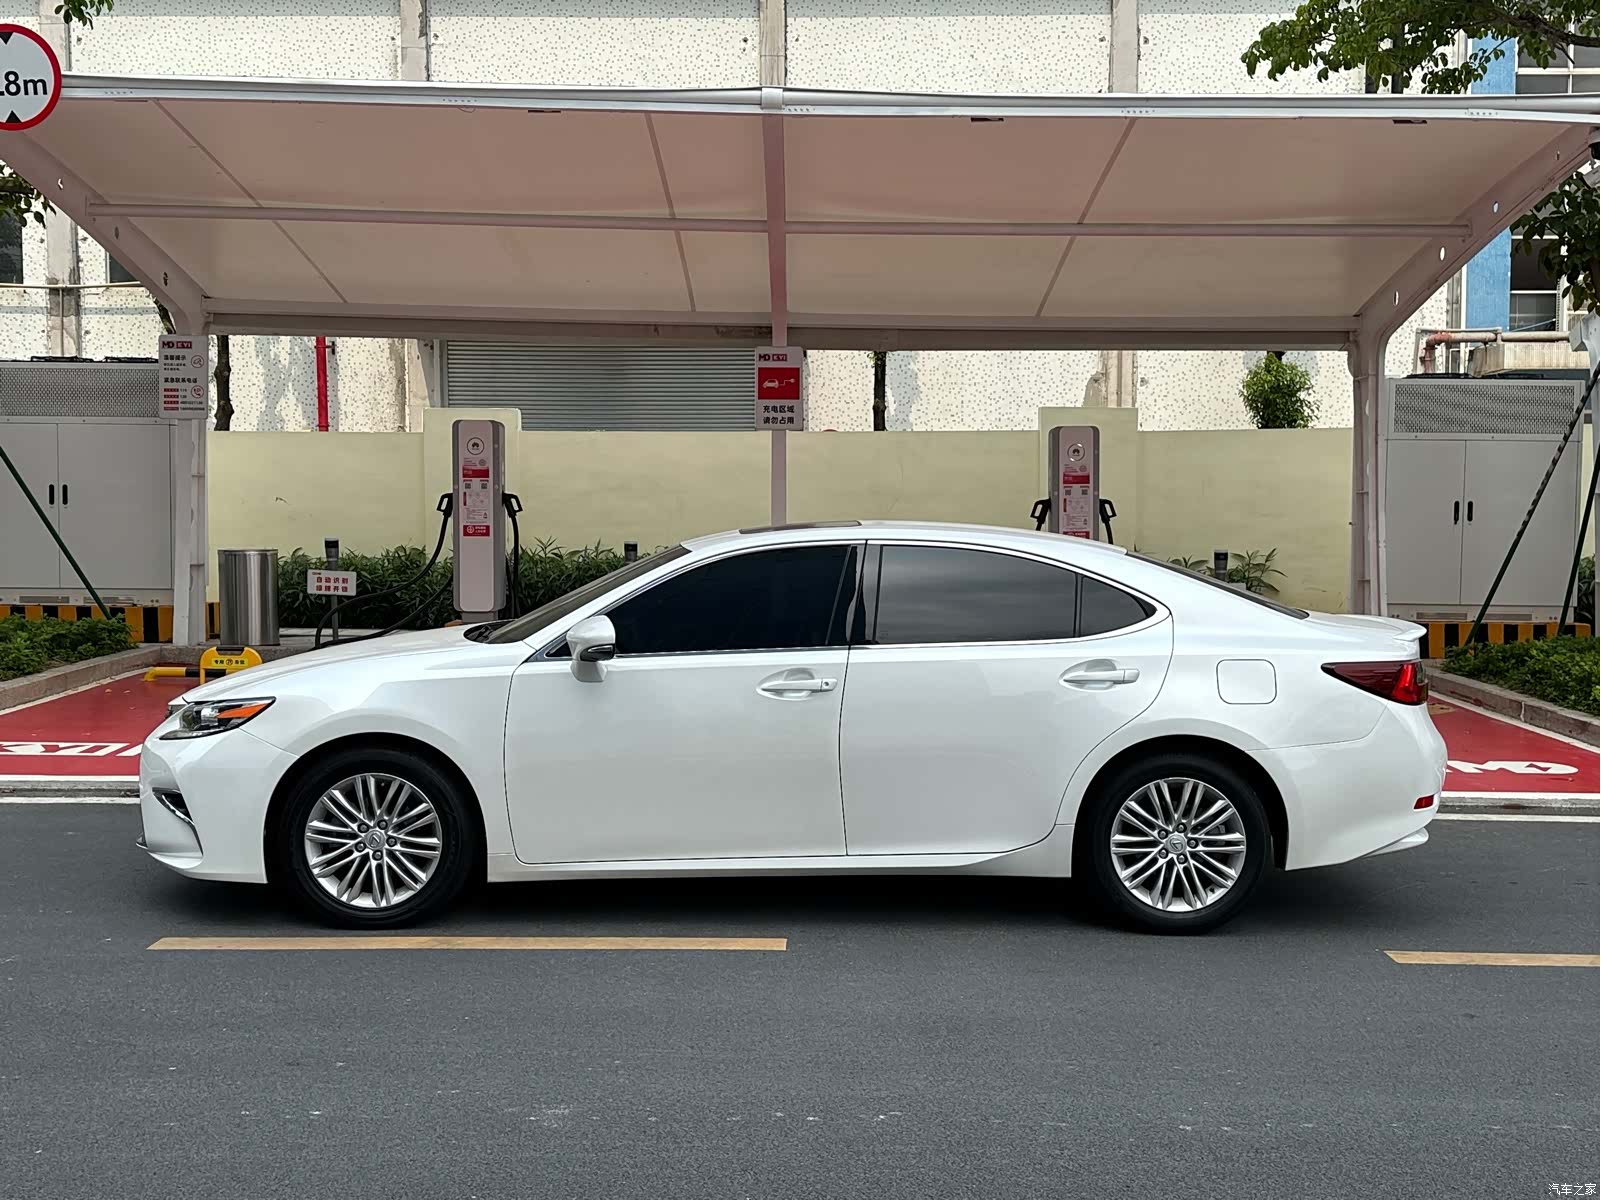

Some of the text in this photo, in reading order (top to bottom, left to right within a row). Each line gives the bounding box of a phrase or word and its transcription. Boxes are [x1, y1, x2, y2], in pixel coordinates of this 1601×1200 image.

[763, 405, 795, 413] 充电区域
[763, 416, 795, 424] 请勿占用
[316, 576, 349, 584] 自动识别
